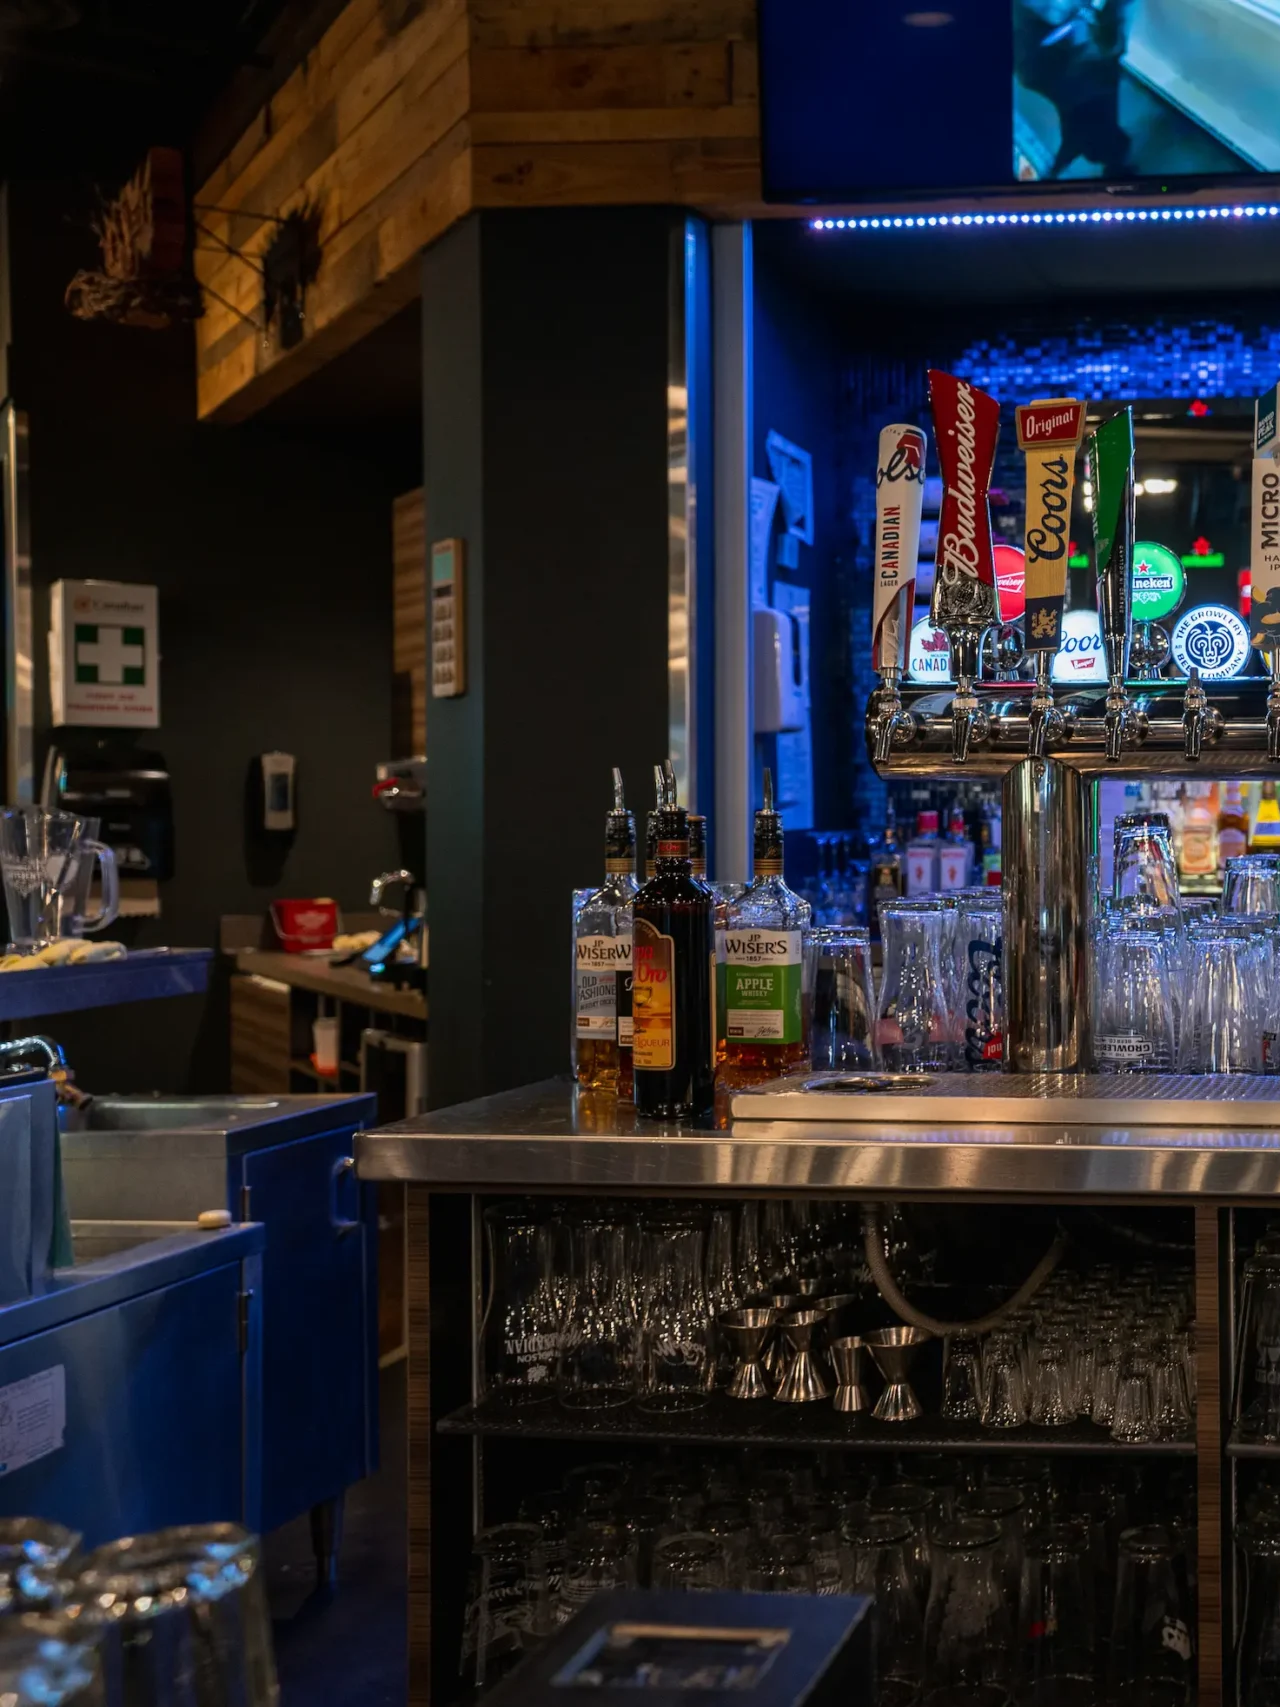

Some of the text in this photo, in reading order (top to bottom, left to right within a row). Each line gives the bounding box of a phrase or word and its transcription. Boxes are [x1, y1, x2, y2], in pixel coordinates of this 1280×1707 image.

[1026, 408, 1074, 439] Original
[941, 381, 979, 586] Budweiser
[1026, 454, 1069, 564] Coors
[1261, 472, 1280, 550] MICRO
[881, 505, 900, 579] CANADIAN
[880, 580, 899, 588] LAGER
[1177, 610, 1243, 640] THE GROWLERY
[1200, 650, 1245, 678] COMPANY
[725, 940, 787, 954] WISER'S
[748, 934, 761, 942] JP
[582, 976, 597, 987] OLD
[736, 979, 774, 991] APPLE
